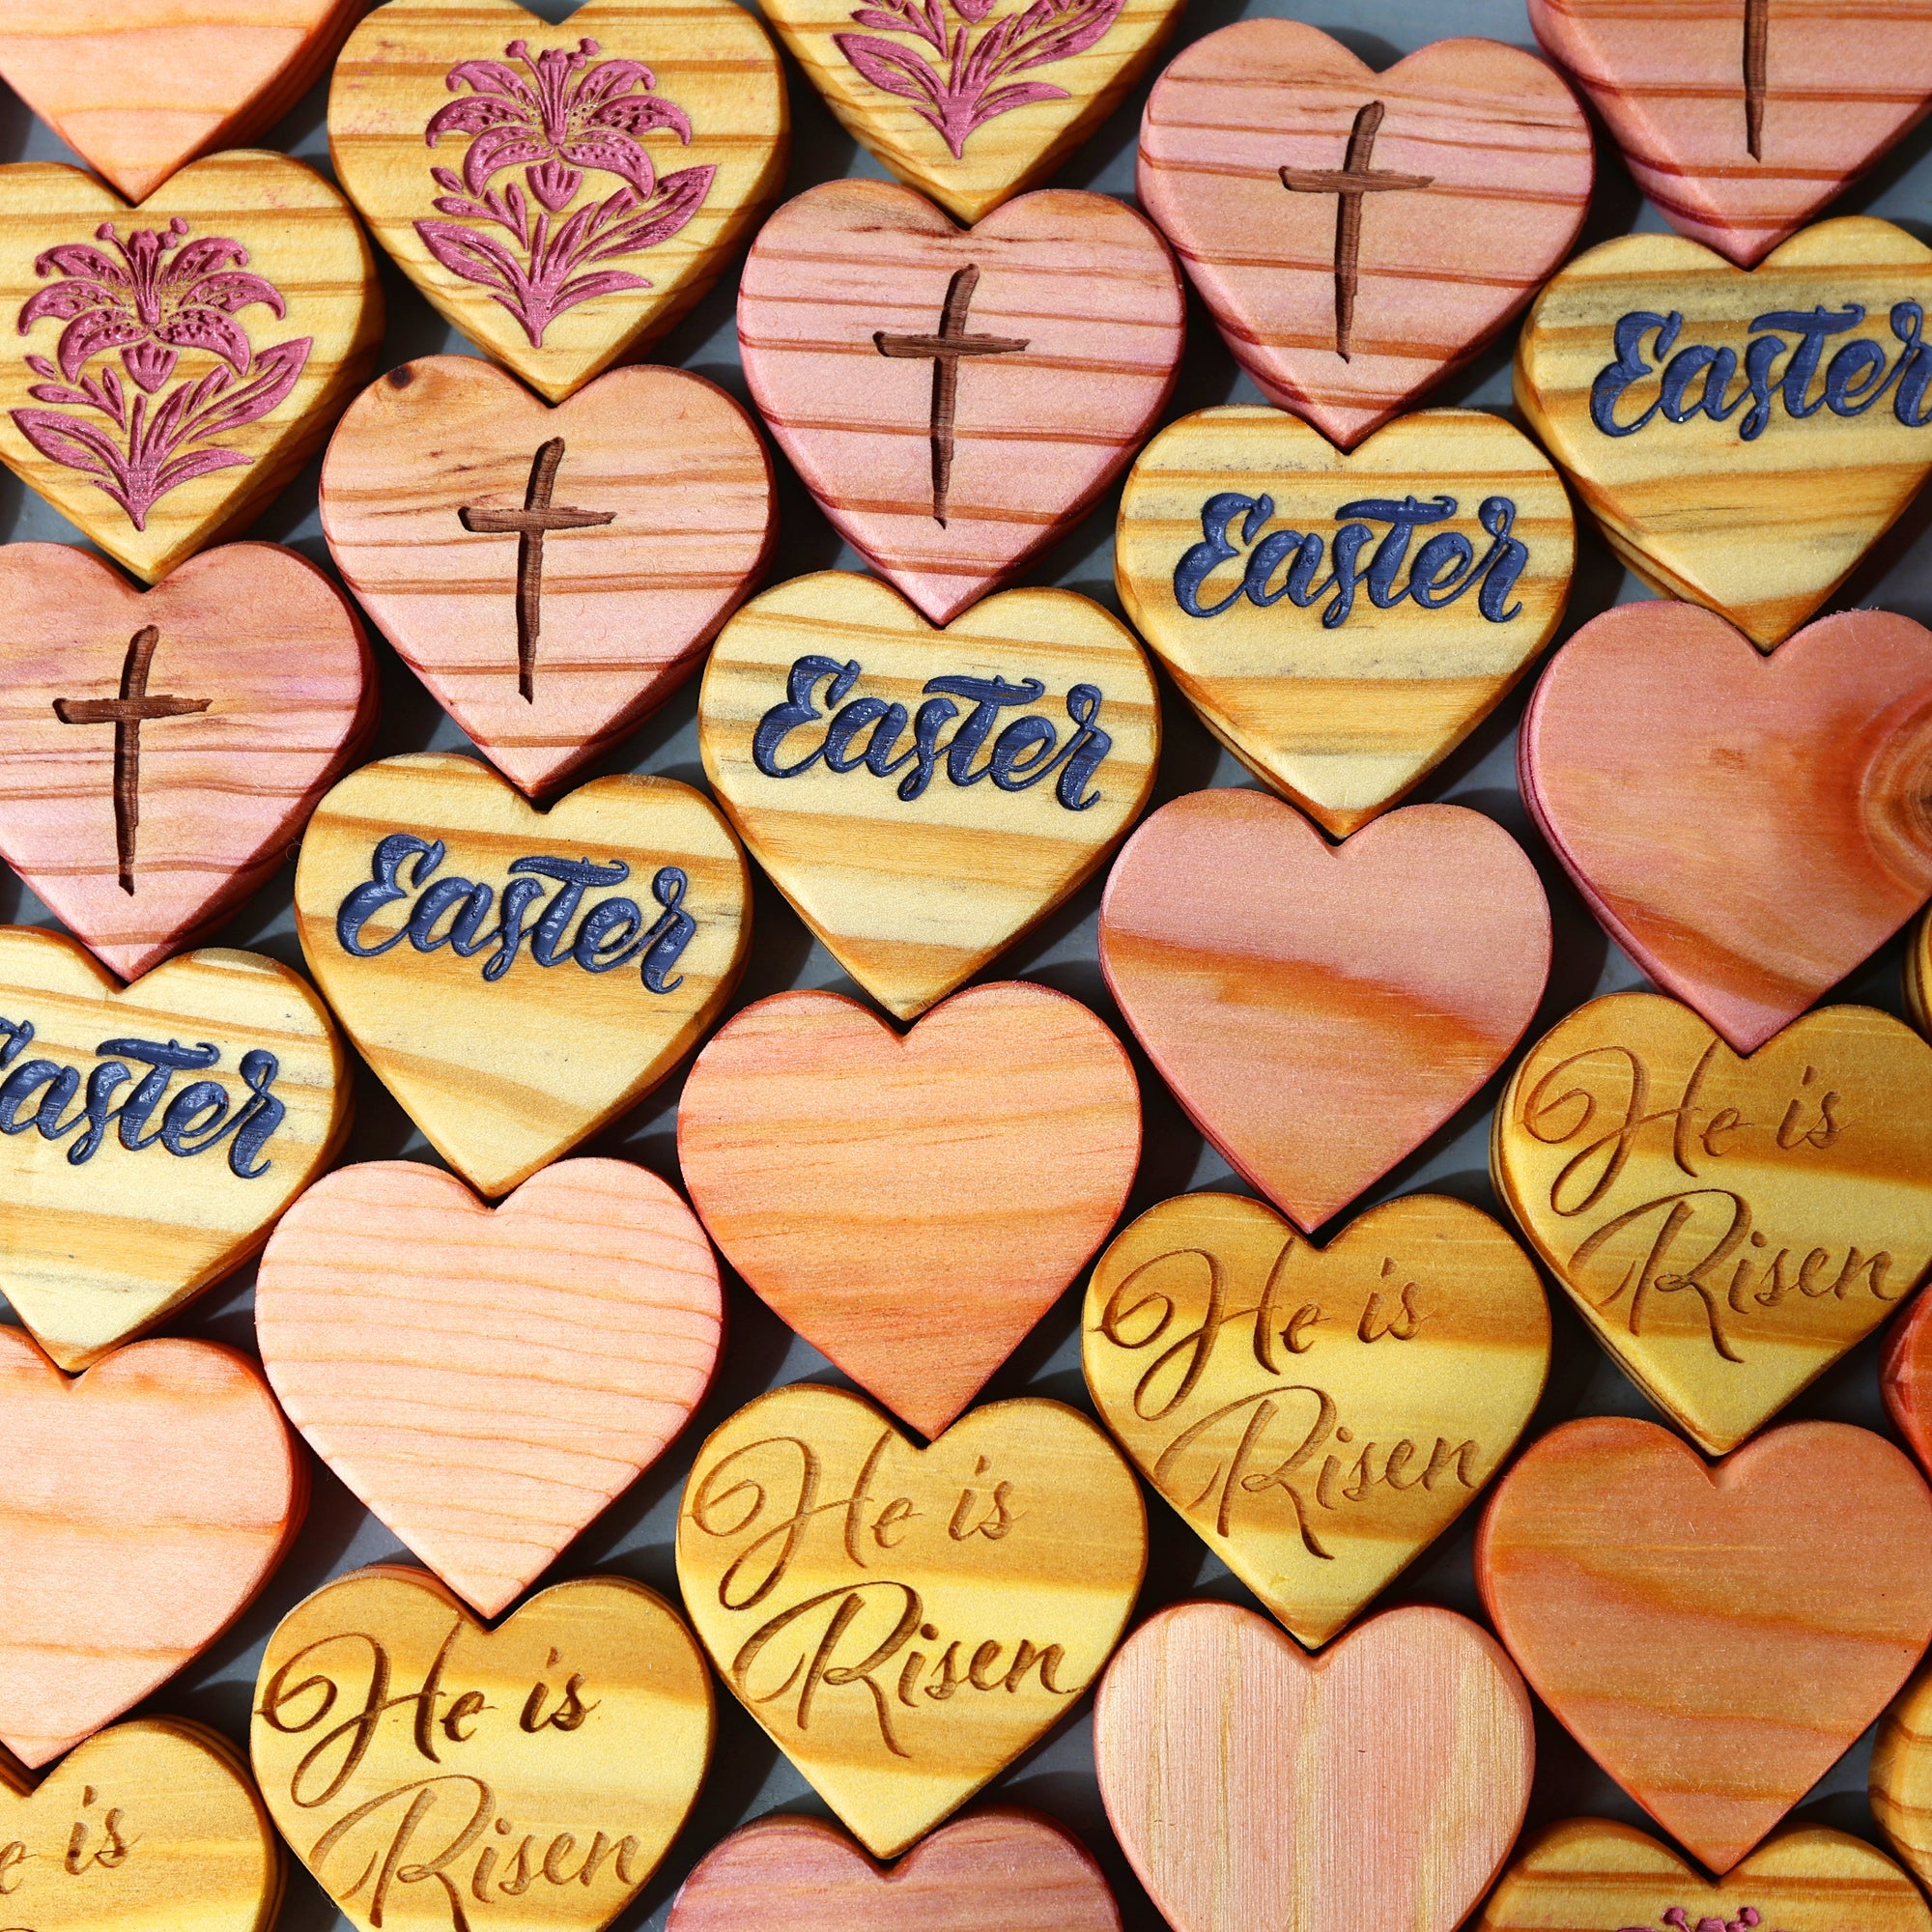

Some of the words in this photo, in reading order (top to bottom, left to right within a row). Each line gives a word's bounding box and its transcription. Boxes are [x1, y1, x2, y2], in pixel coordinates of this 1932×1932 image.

[1174, 493, 1528, 629] Easter
[753, 654, 1112, 811] Easter
[336, 833, 696, 994] Easter
[0, 1018, 286, 1179] aster
[1519, 1037, 1753, 1217] He
[1776, 1065, 1854, 1150] is
[1088, 1236, 1330, 1421] He
[1357, 1257, 1435, 1344] is
[1568, 1188, 1901, 1364] Risen
[684, 1430, 923, 1610] He
[948, 1454, 1027, 1542] is
[1152, 1384, 1481, 1560] Risen
[254, 1619, 498, 1807] He
[520, 1646, 602, 1733] is
[730, 1580, 1085, 1758] Risen
[65, 1785, 143, 1875] is
[307, 1774, 644, 1932] Risen
